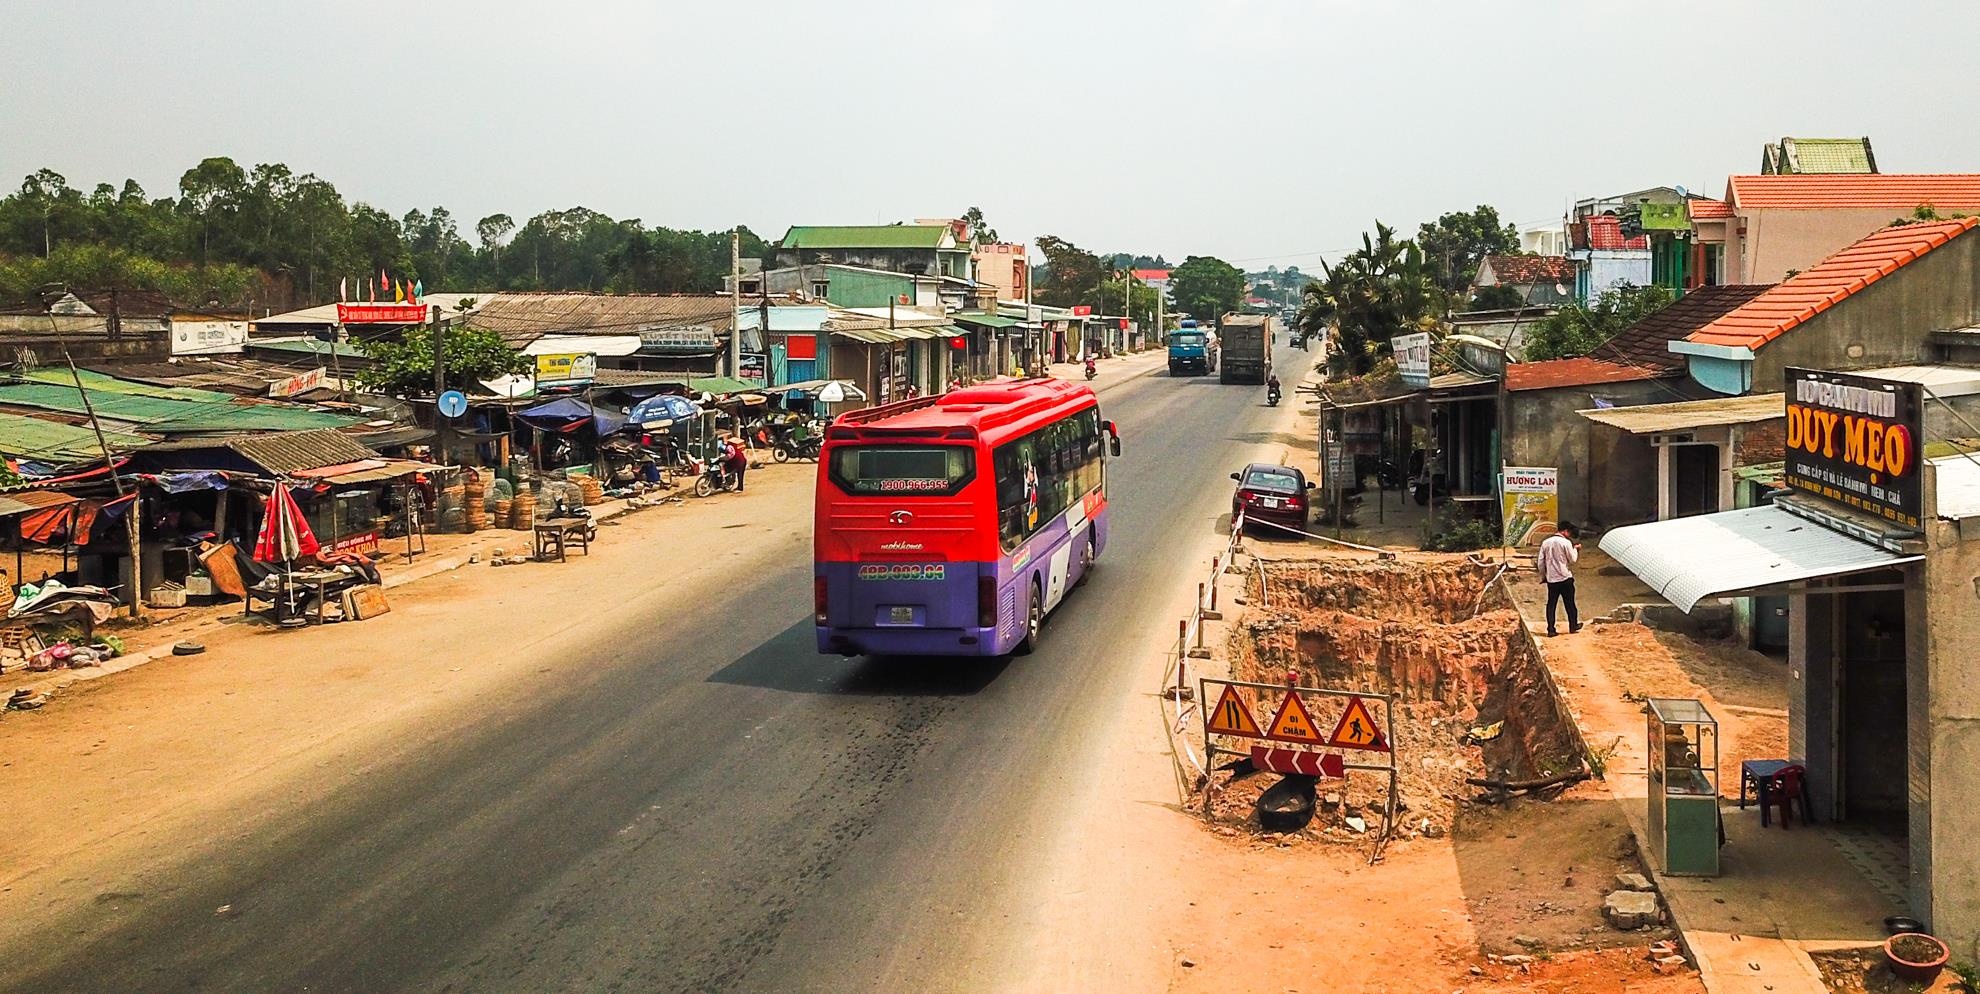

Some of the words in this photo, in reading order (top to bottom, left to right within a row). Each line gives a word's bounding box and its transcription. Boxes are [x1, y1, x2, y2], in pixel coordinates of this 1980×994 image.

[1787, 404, 1838, 458] DUY
[1844, 415, 1908, 484] MẸO
[1506, 475, 1536, 485] HƯƠNG
[1538, 477, 1555, 486] LAN
[881, 541, 923, 550] mobihome
